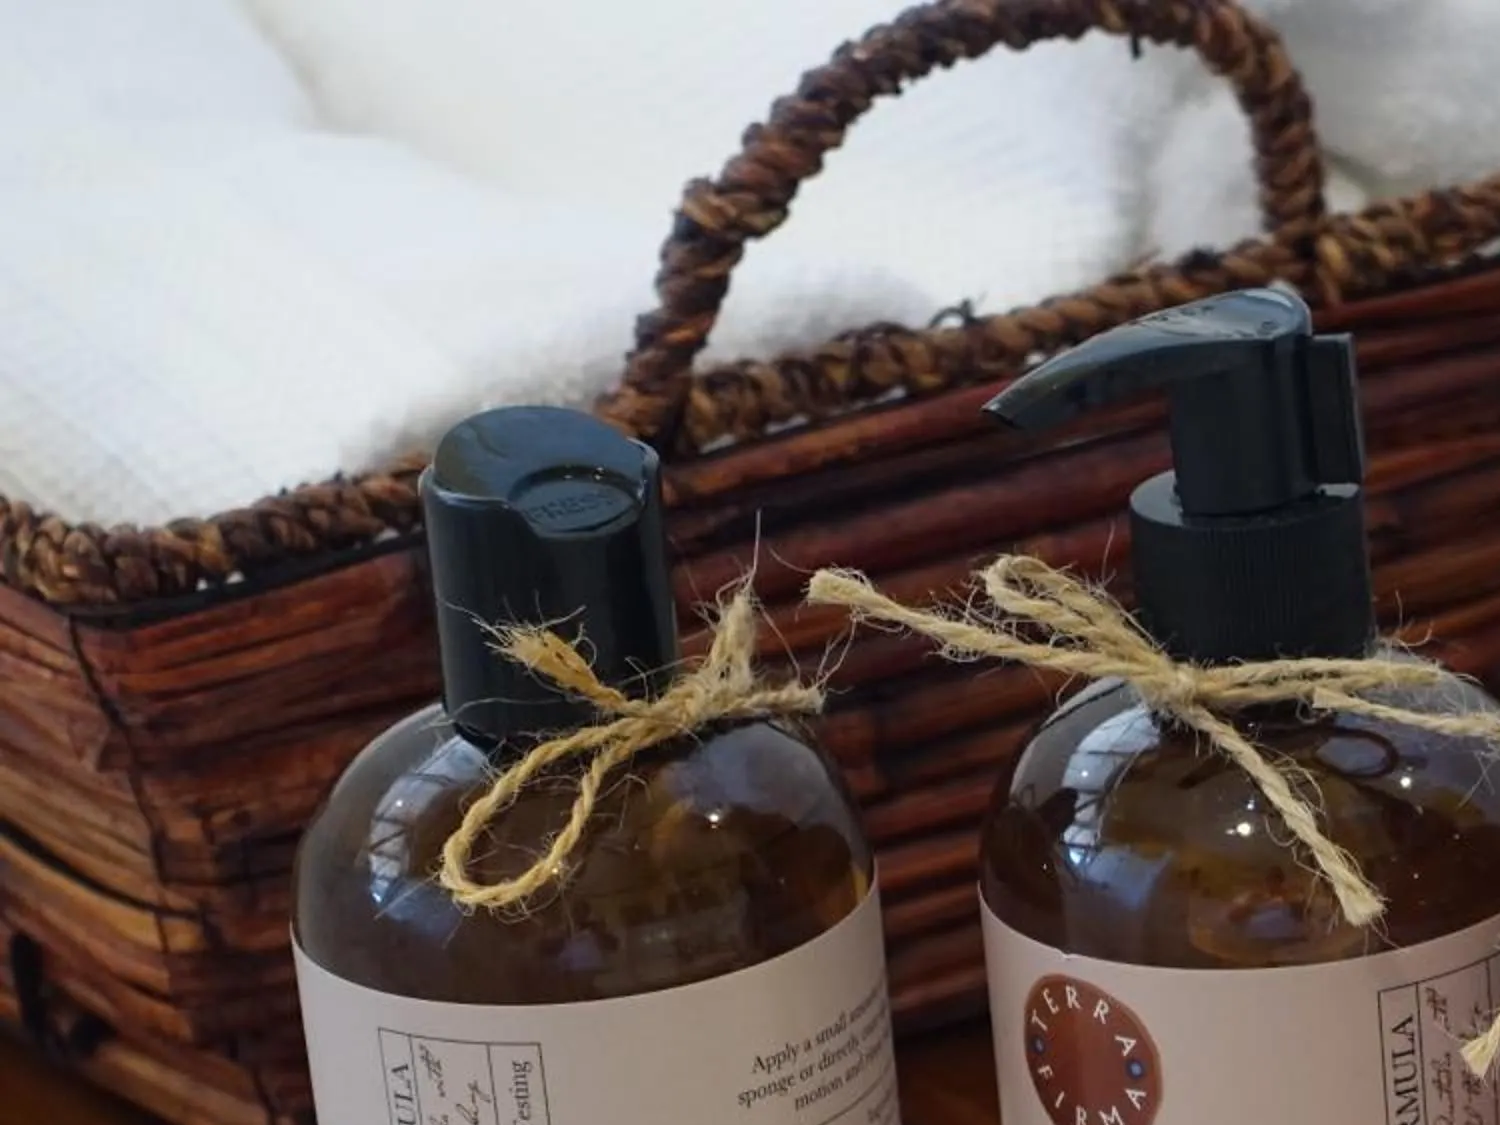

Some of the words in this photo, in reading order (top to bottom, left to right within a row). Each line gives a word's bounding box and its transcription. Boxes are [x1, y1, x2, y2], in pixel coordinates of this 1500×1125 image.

[1031, 984, 1137, 1057] TERRA
[752, 1041, 800, 1075] Apply
[803, 1038, 812, 1052] a
[737, 1073, 797, 1108] sponge
[799, 1064, 815, 1083] or
